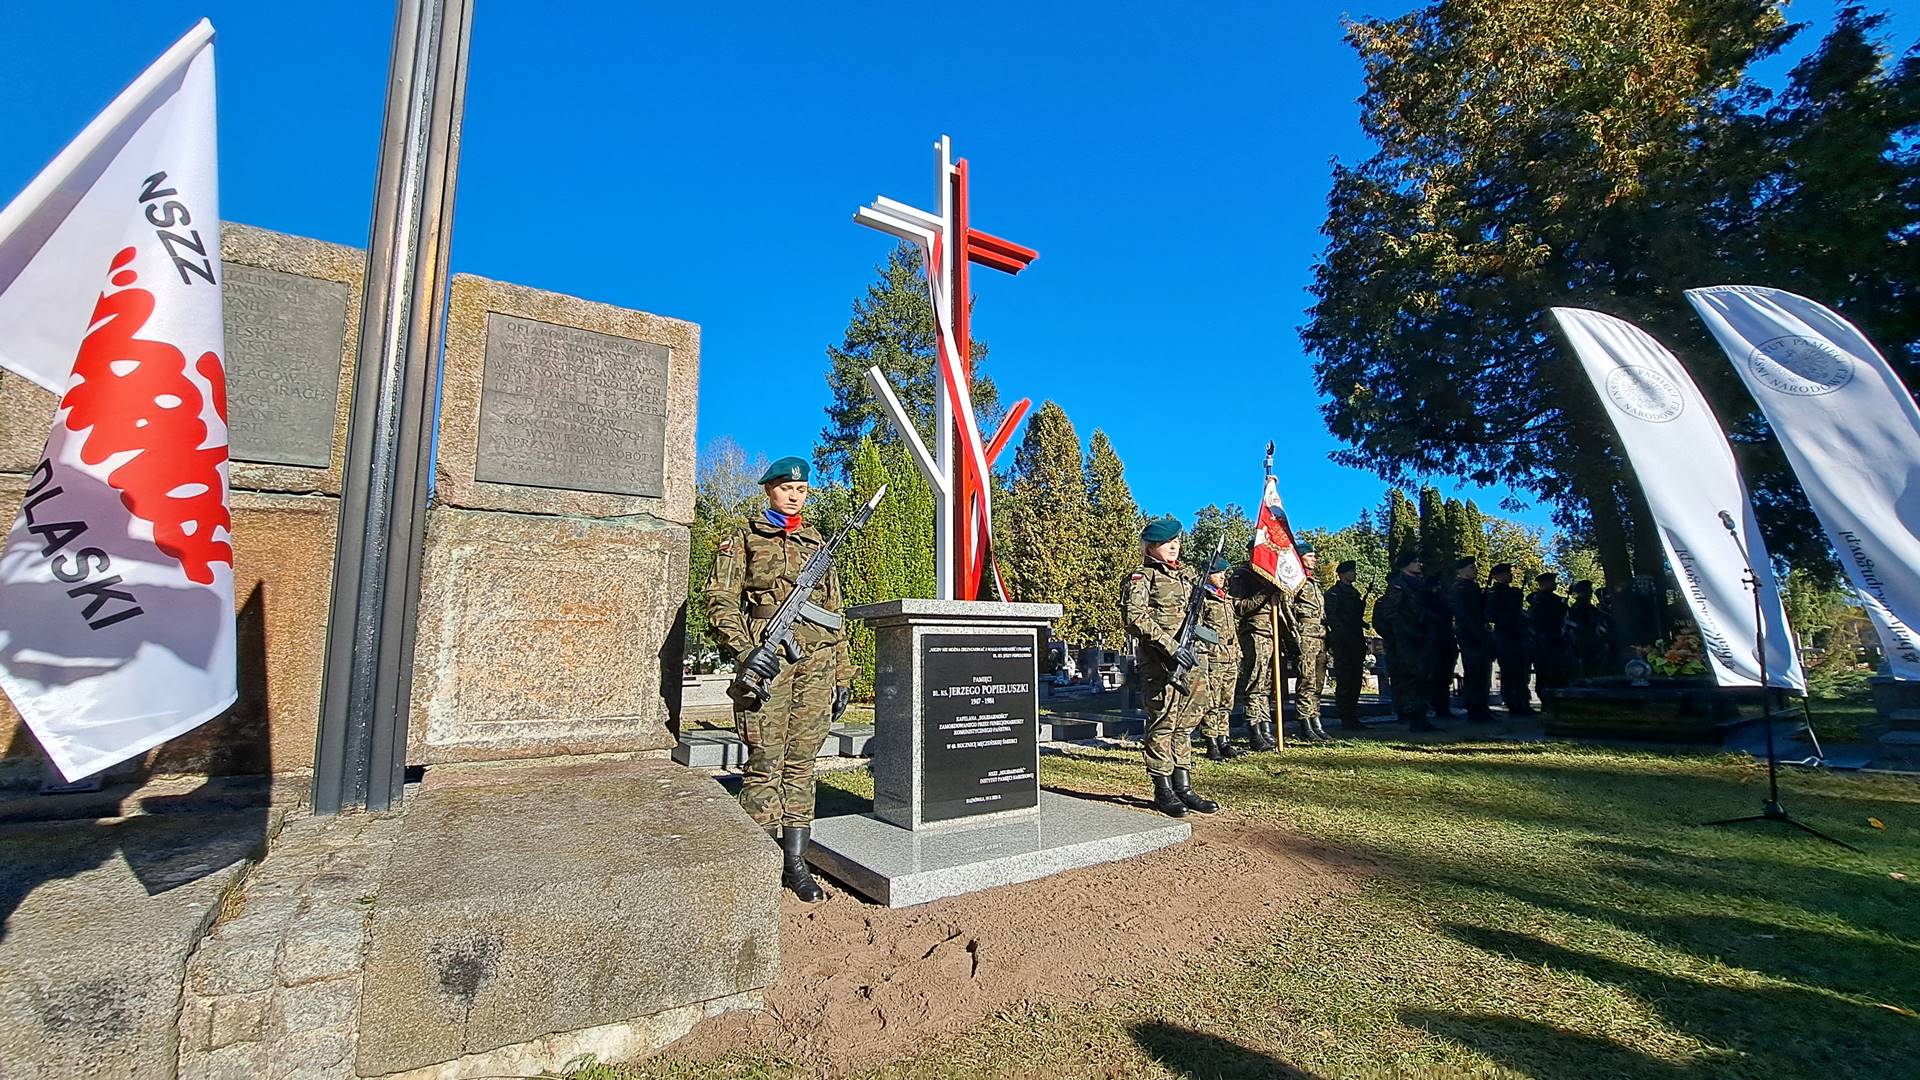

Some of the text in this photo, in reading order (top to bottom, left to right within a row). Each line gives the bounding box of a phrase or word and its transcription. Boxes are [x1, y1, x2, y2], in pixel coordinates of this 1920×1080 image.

[138, 171, 216, 285] NSZZ
[948, 686, 980, 698] JERZEGO
[982, 684, 1029, 695] POPIEŁUSZKI
